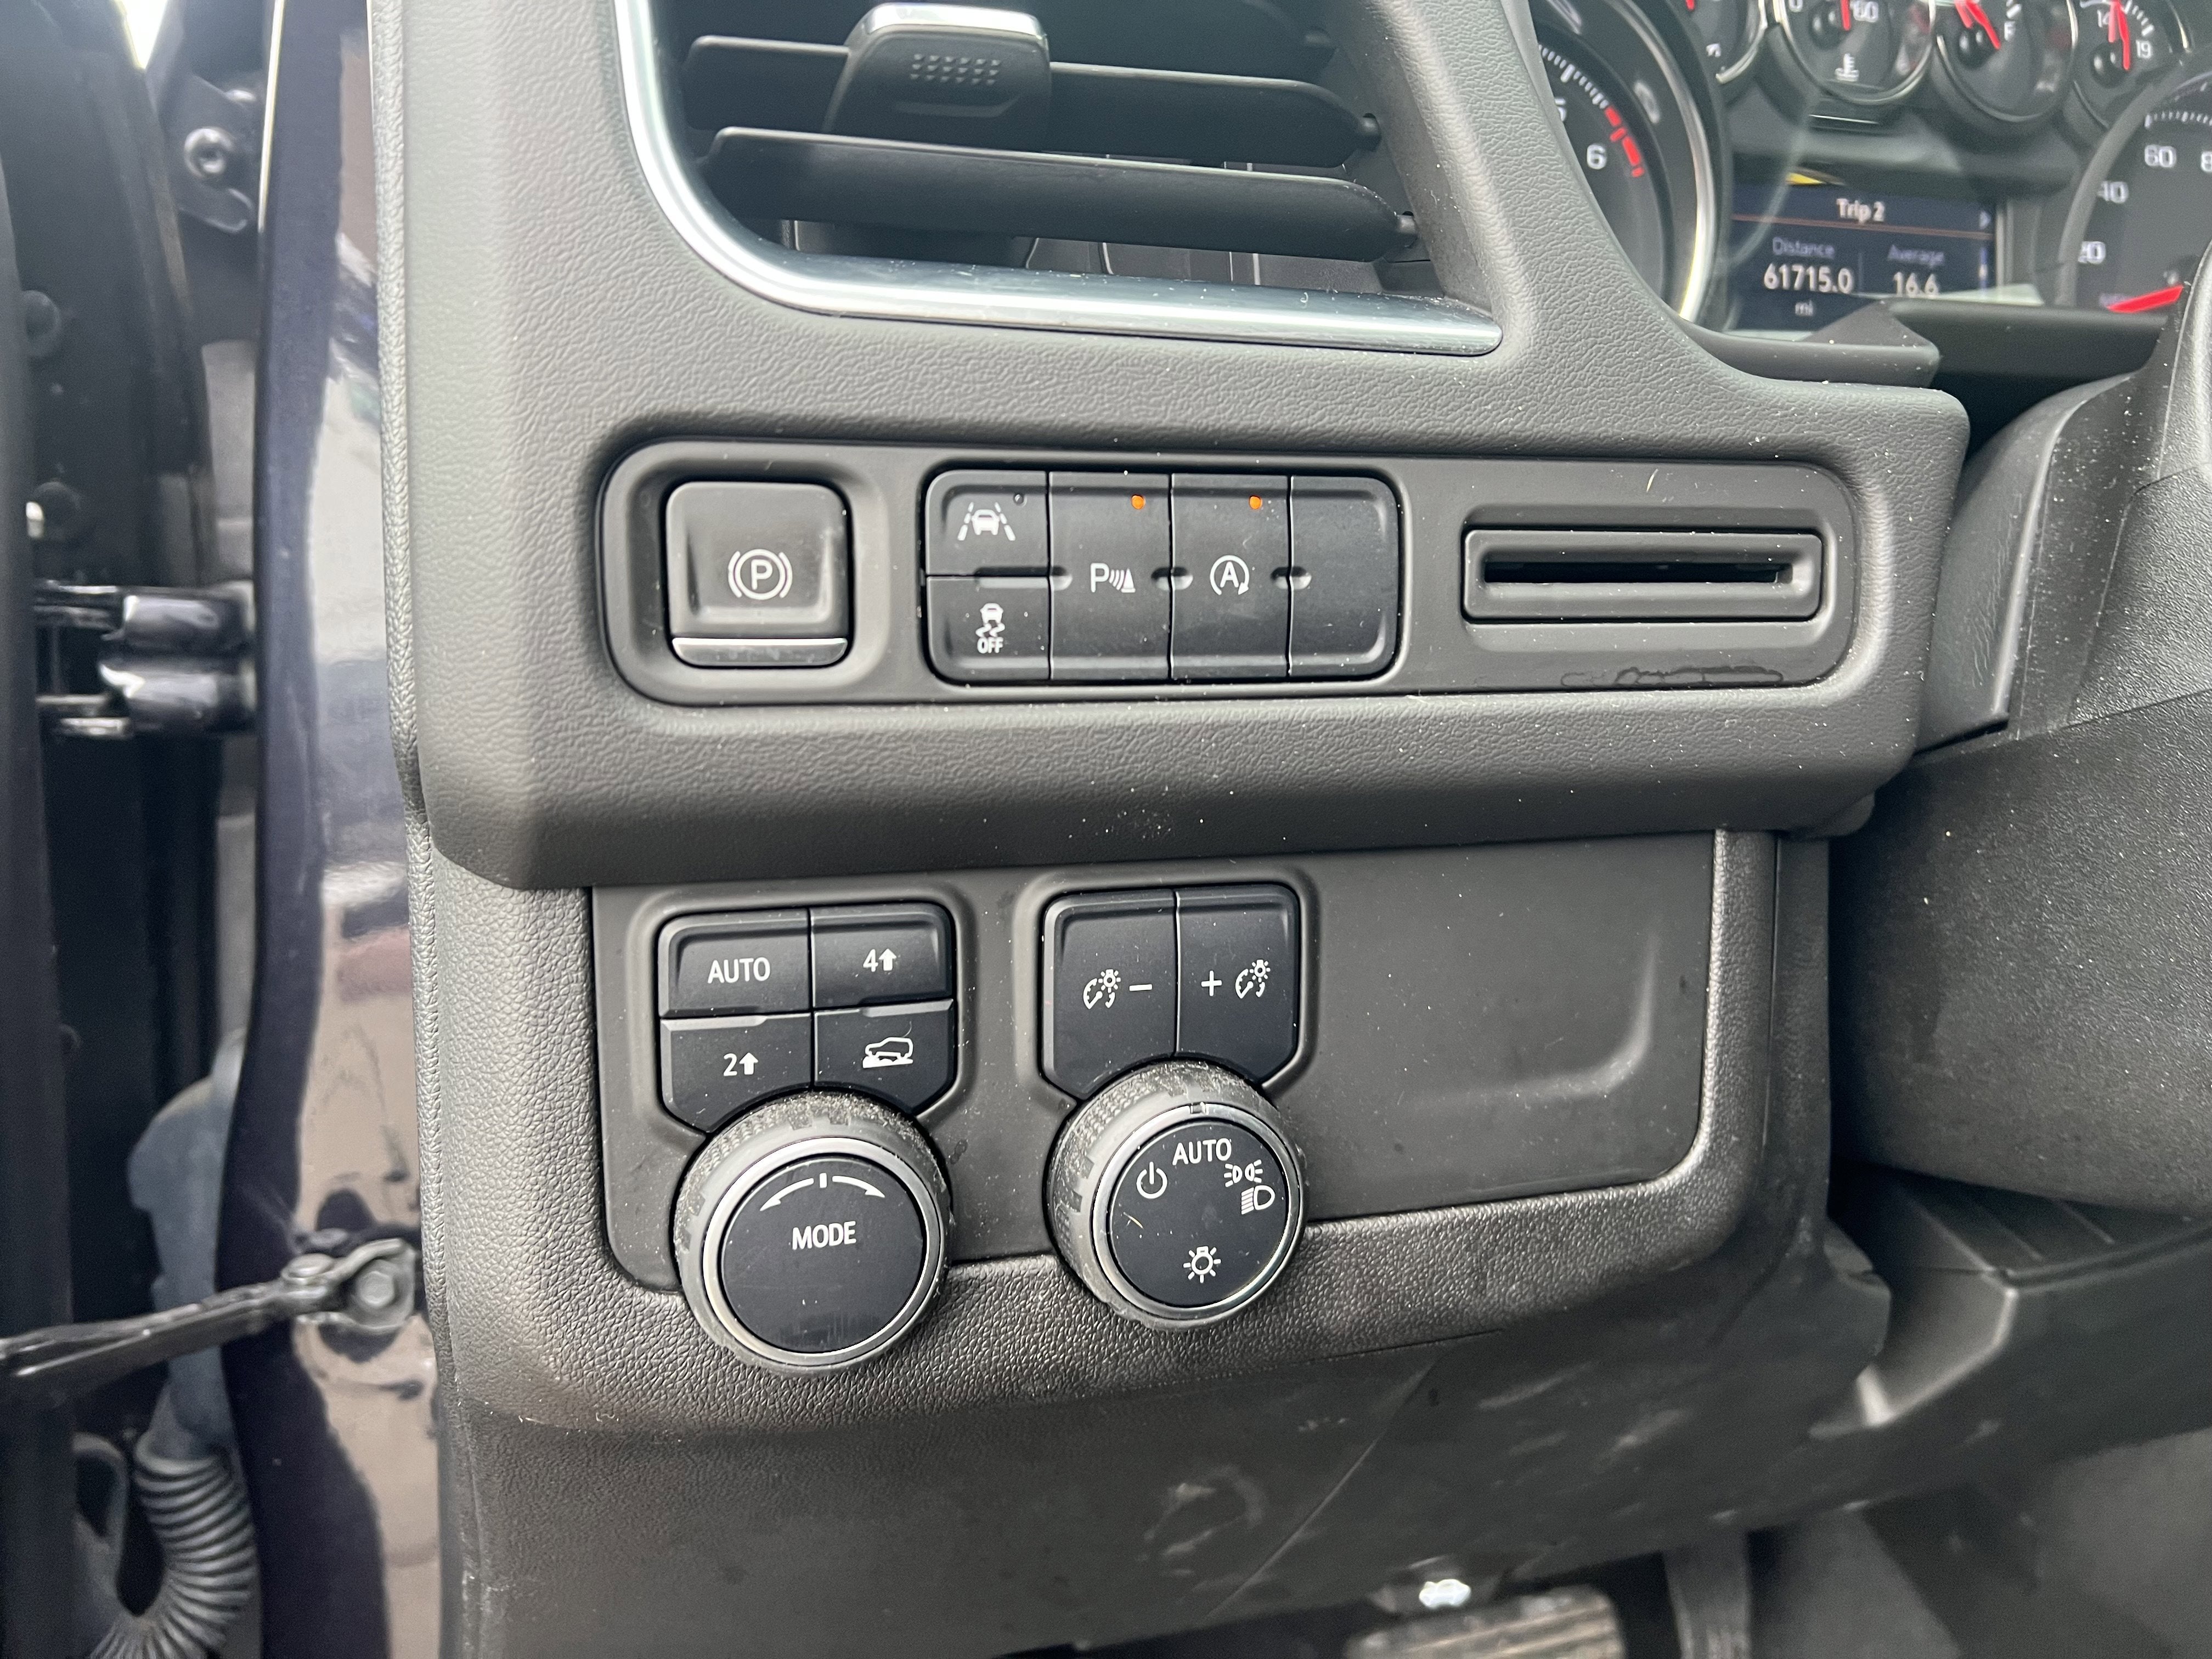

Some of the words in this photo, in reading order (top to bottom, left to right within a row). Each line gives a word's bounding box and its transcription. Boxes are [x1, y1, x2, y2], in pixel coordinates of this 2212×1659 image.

[2004, 21, 2016, 41] F
[2136, 40, 2153, 59] 19
[1587, 144, 1607, 170] 6
[2144, 144, 2177, 168] 60
[1836, 198, 1871, 224] Trip
[1873, 201, 1885, 222] 2
[1772, 236, 1836, 258] Distance
[1887, 244, 1945, 268] Average
[1763, 262, 1854, 294] 61715.0
[1892, 271, 1940, 297] 16.6
[1795, 300, 1814, 317] mi
[751, 559, 773, 590] P
[1220, 561, 1239, 588] A
[977, 637, 1003, 654] OFF
[708, 957, 770, 984] AUTO
[862, 949, 878, 972] 4
[723, 1053, 738, 1076] 2
[1172, 1138, 1232, 1166] AUTO
[792, 1221, 857, 1250] MODE
